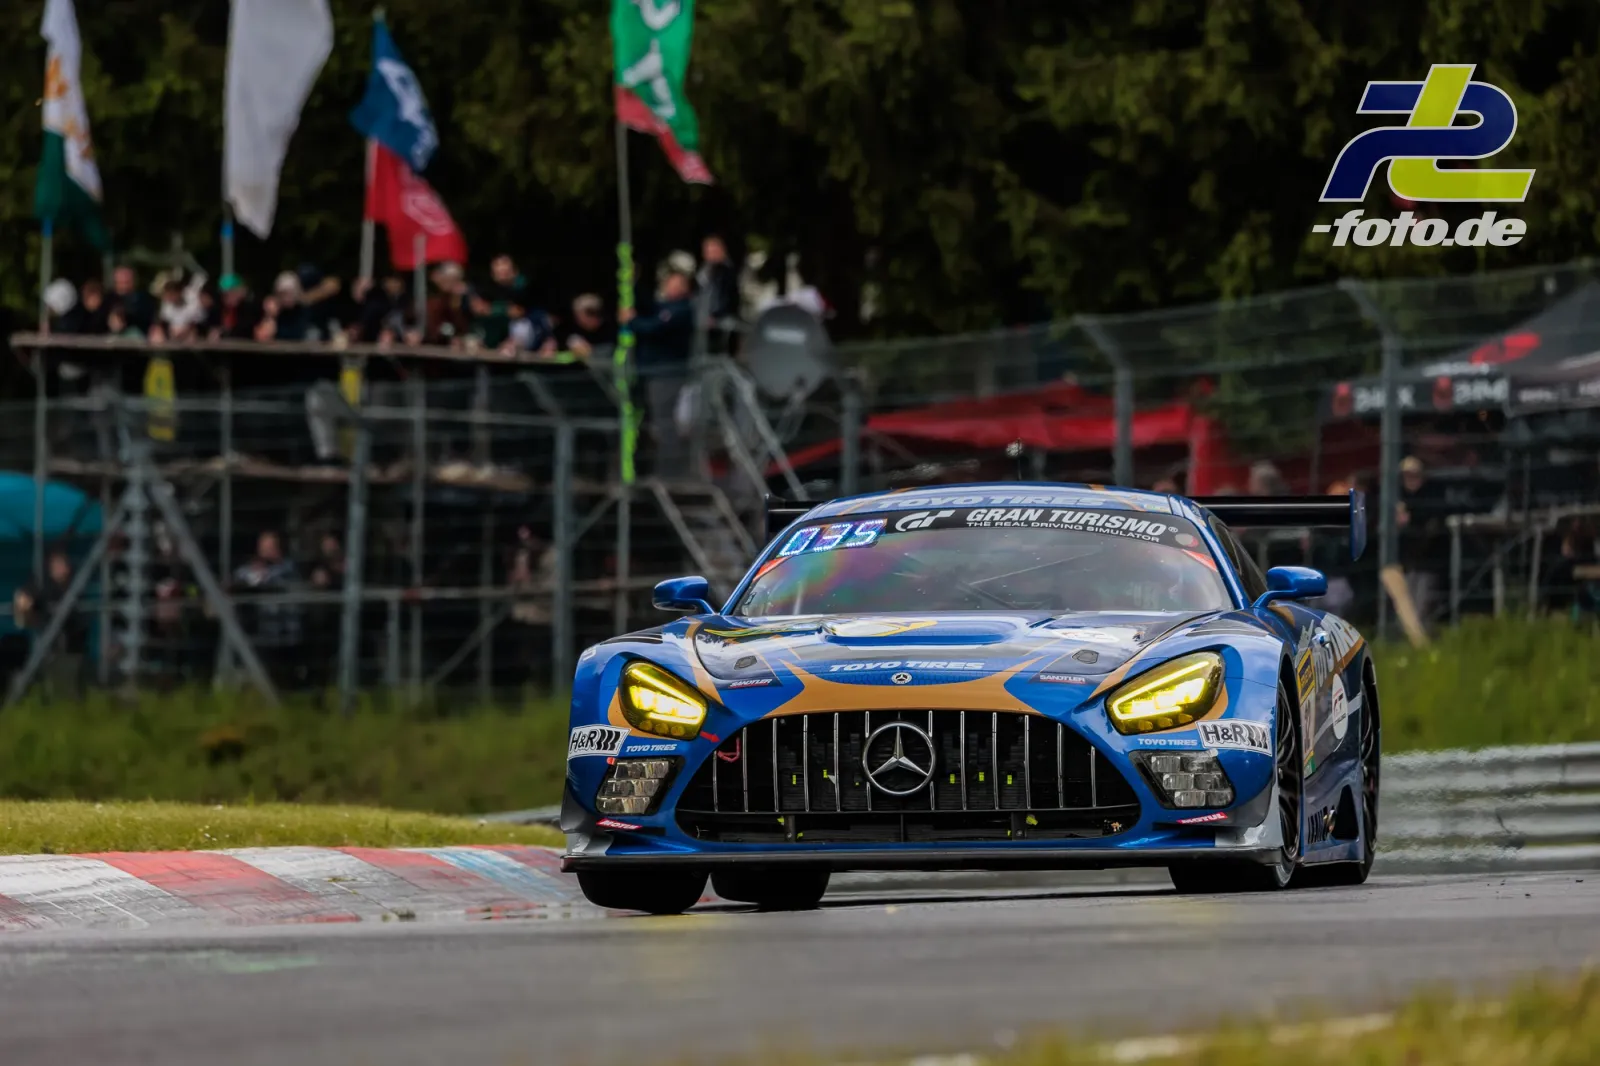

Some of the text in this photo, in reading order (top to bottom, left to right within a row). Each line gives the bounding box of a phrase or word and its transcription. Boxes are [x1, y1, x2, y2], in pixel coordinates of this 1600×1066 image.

[877, 495, 1107, 509] TOYO TIRES
[966, 508, 1044, 523] GRAN
[778, 518, 885, 557] 035
[1031, 521, 1084, 532] DRIVING
[1086, 526, 1161, 543] SIMULATOR
[829, 661, 986, 673] TOYO TIRES
[1202, 722, 1247, 743] H&R
[626, 743, 678, 753] TOYO TIRES
[1137, 737, 1198, 746] TOYO TIRES
